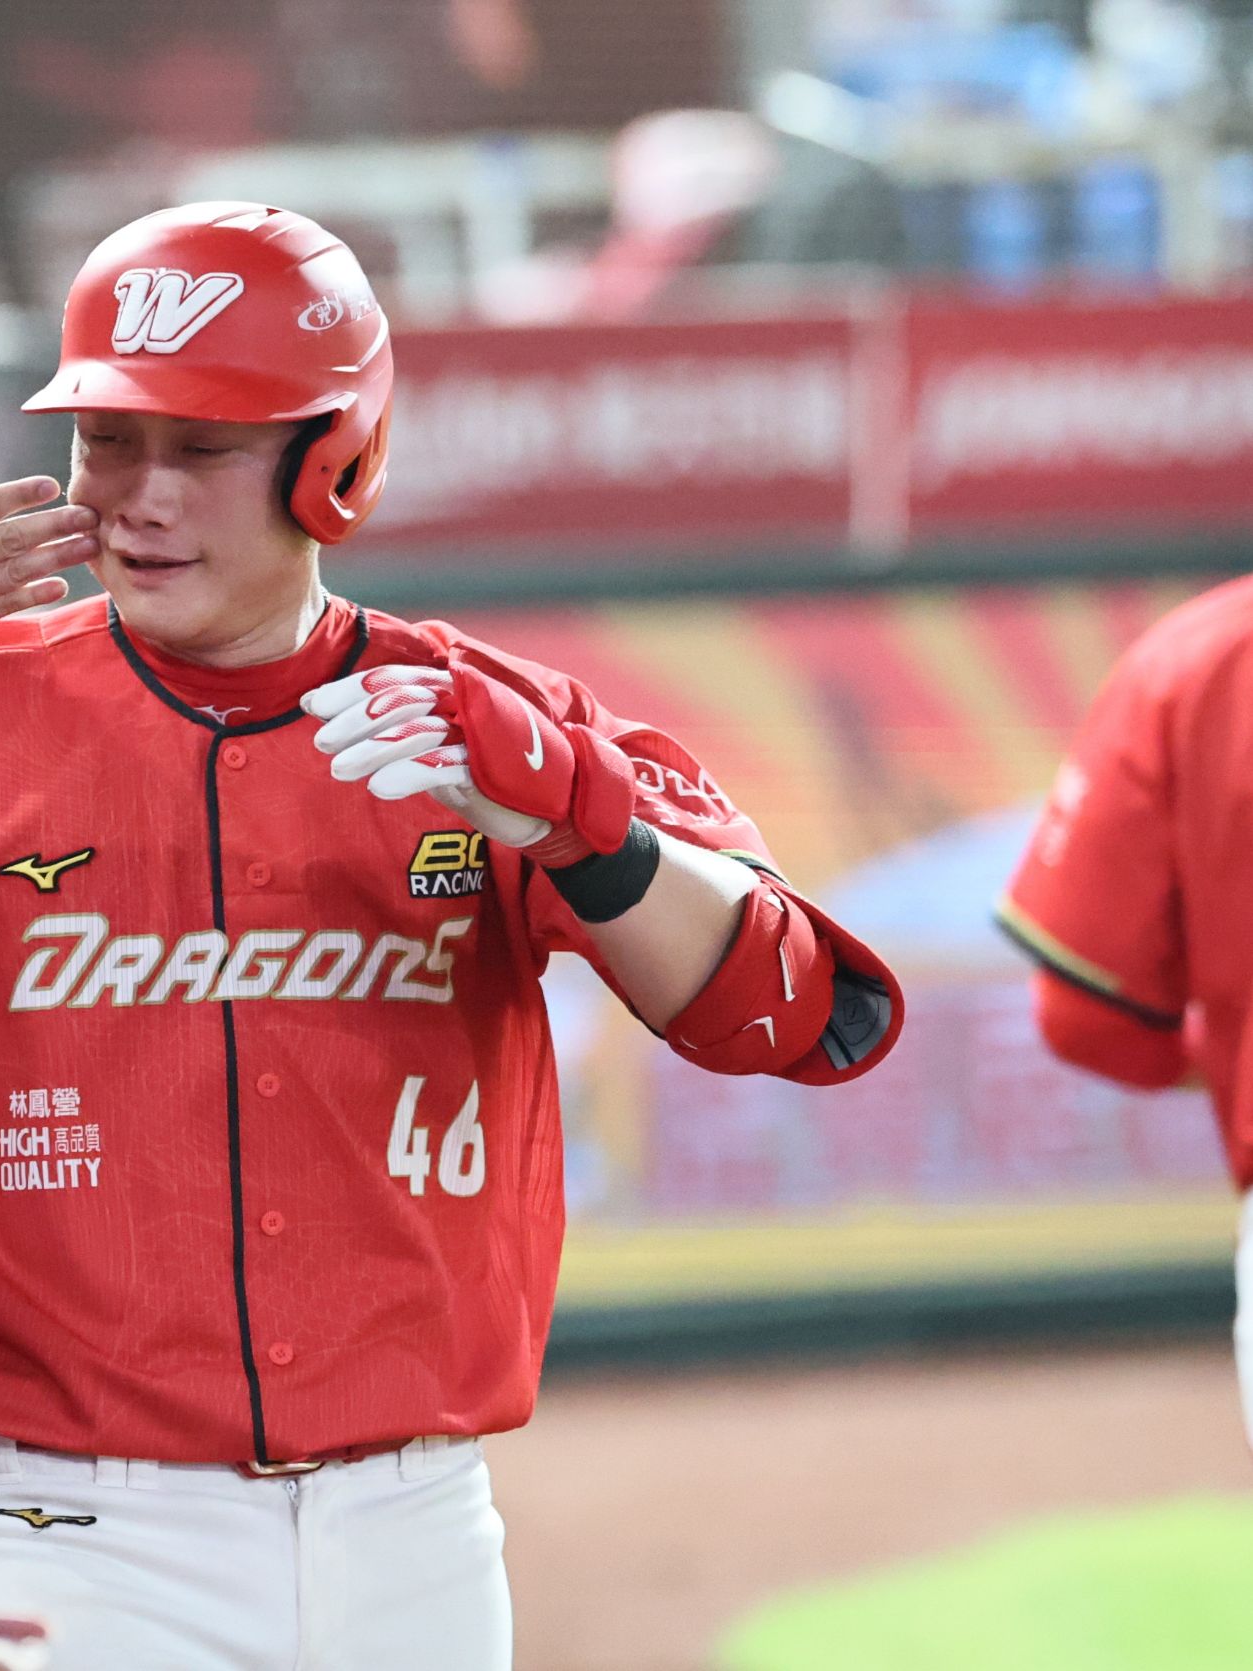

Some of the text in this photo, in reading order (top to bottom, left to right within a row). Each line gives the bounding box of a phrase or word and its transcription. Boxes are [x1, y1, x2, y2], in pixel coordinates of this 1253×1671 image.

[111, 267, 244, 355] W
[9, 1087, 81, 1118] 林鳳營
[0, 1123, 101, 1158] HIGH 高品質
[387, 1075, 486, 1197] 46
[0, 1157, 101, 1191] QUALITY
